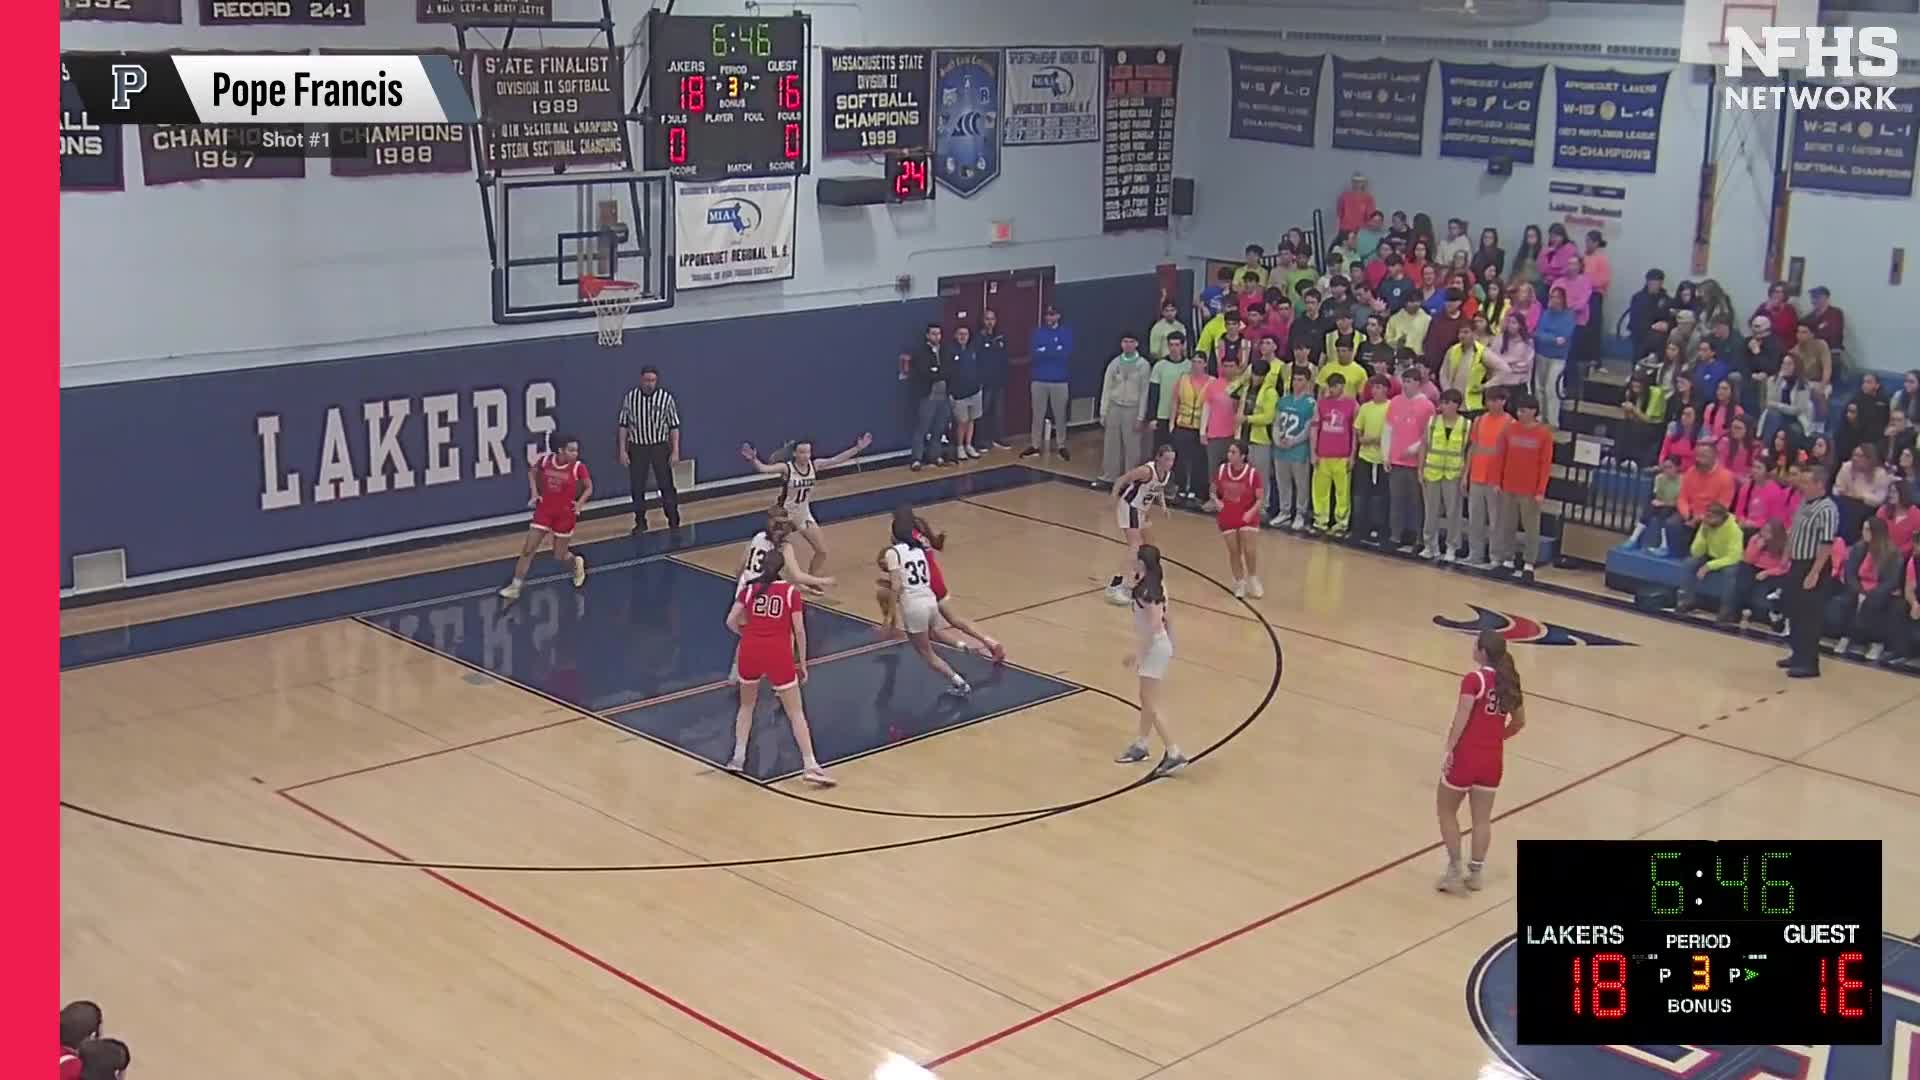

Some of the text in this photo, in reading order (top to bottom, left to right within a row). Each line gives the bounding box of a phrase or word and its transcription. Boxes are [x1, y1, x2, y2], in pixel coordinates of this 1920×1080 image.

[213, 2, 351, 17] RECORD 24-1
[712, 23, 771, 56] 6:46
[540, 56, 620, 74] FINALIST
[720, 65, 748, 75] PERIOD
[767, 60, 798, 72] GUEST
[832, 55, 896, 72] MASSACHUSETTS
[899, 55, 924, 70] STATE
[496, 80, 539, 95] DIVISION
[558, 78, 610, 93] SOFTBALL
[728, 76, 739, 97] 3
[857, 74, 898, 90] DIVISION II
[680, 74, 801, 113] 18 16
[836, 92, 918, 110] SOFTBALL
[532, 99, 578, 115] 1989
[719, 98, 746, 109] BONUS
[1621, 106, 1655, 118] L-4
[705, 112, 734, 123] PLAYER
[744, 112, 765, 122] FOUL
[777, 111, 801, 121] FOULS
[834, 111, 919, 129] CHAMPIONS
[340, 124, 464, 145] CHAMPIONS
[669, 122, 801, 164] 0 0
[861, 130, 897, 147] 1999
[375, 146, 432, 165] 1988
[489, 142, 529, 160] ESTERN
[1559, 145, 1651, 160] CO-CHAMPIONS
[727, 163, 753, 174] MATCH
[769, 161, 796, 171] SCORE
[896, 161, 924, 194] 24
[708, 210, 738, 221] MIAA
[256, 382, 556, 511] LAKERS
[748, 547, 766, 573] 13
[904, 561, 928, 586] 33
[754, 595, 784, 618] 20
